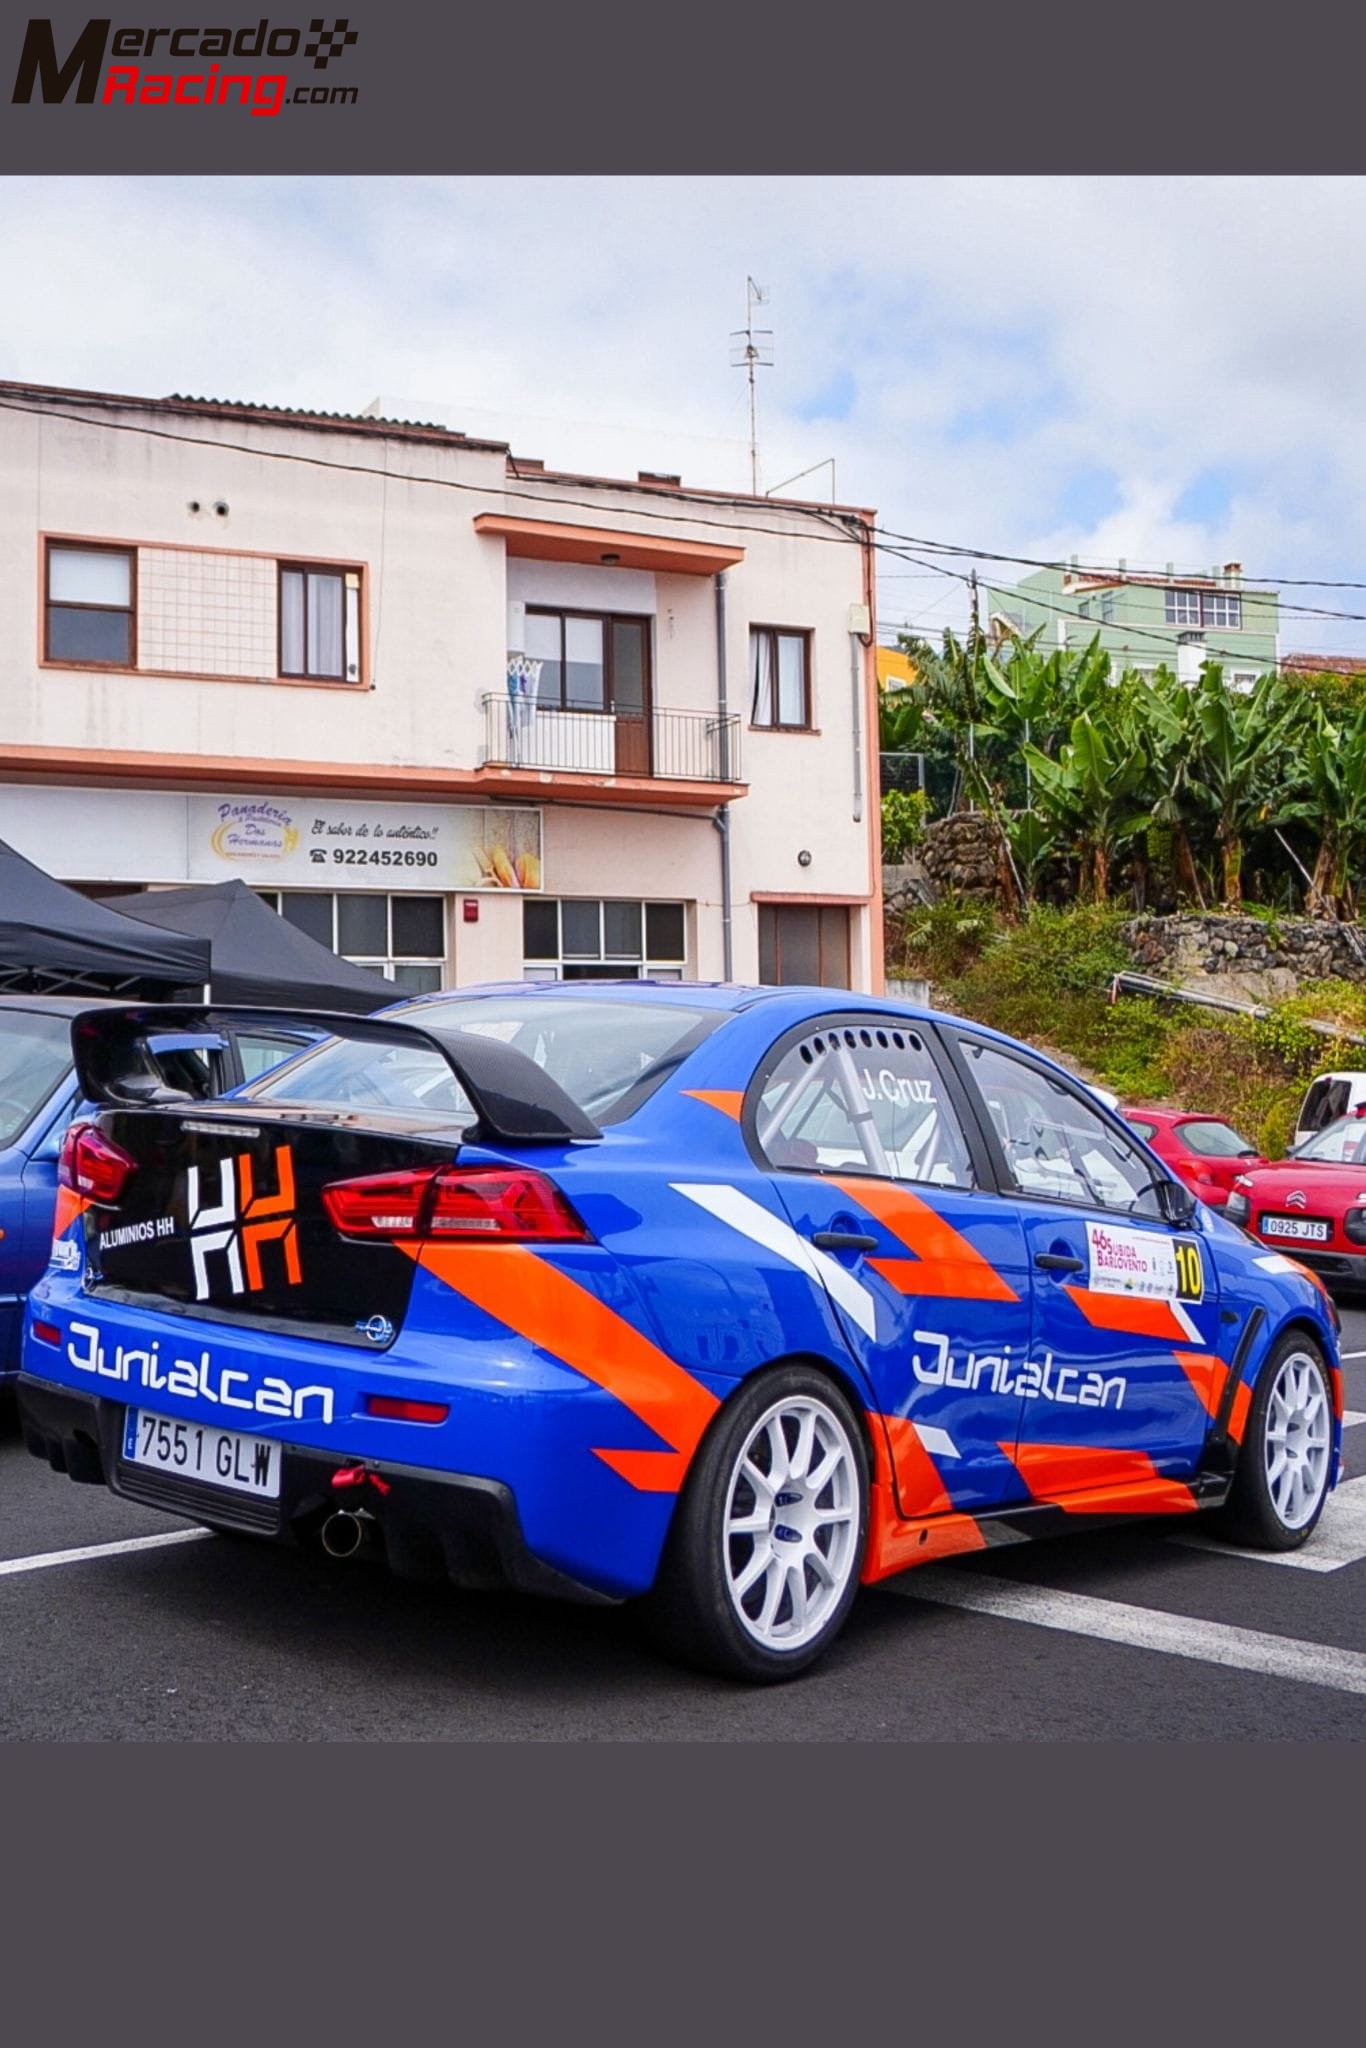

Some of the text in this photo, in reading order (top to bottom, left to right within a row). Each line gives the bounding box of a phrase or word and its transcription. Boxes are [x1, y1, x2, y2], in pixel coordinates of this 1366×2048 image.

[311, 819, 326, 835] El
[326, 822, 353, 836] sabor
[355, 823, 369, 838] de
[333, 848, 438, 867] 922452690
[99, 1216, 174, 1251] ALUMINIOS HH
[1270, 1221, 1325, 1238] 0925 JTS
[1097, 1250, 1148, 1273] BARLOVENTO
[1175, 1245, 1201, 1295] 10
[67, 1322, 334, 1425] Junialcan
[911, 1329, 1127, 1411] Junialcan
[142, 1415, 271, 1487] 7551 GLW
